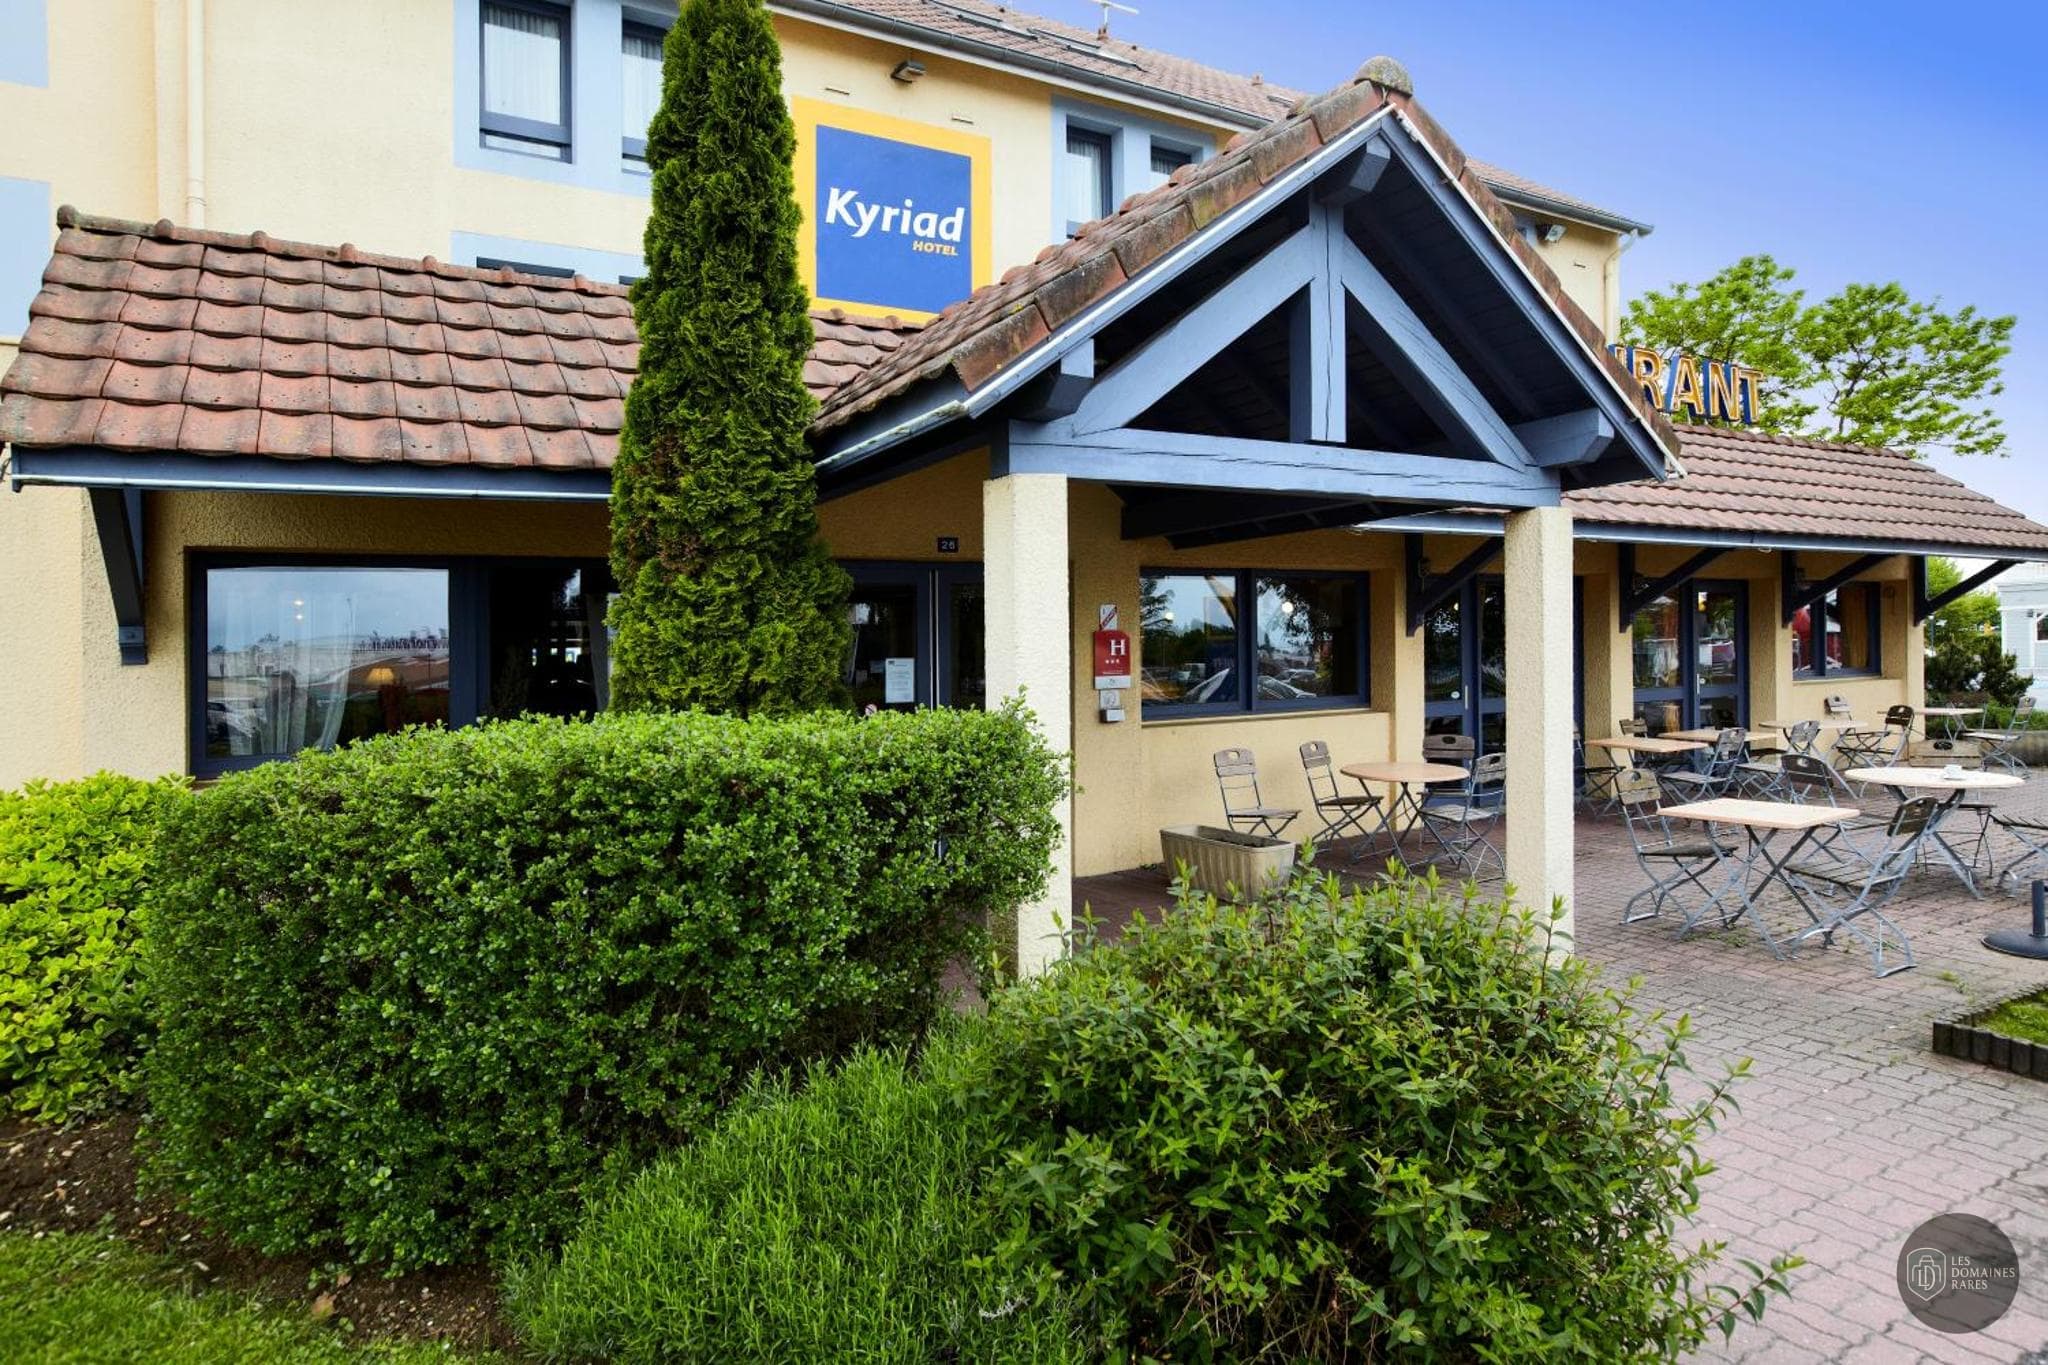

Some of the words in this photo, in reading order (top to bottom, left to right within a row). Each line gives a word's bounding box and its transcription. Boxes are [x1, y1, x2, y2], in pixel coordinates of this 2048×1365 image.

[825, 187, 965, 242] Kyriad
[912, 240, 958, 256] HOTEL
[1110, 639, 1126, 656] H
